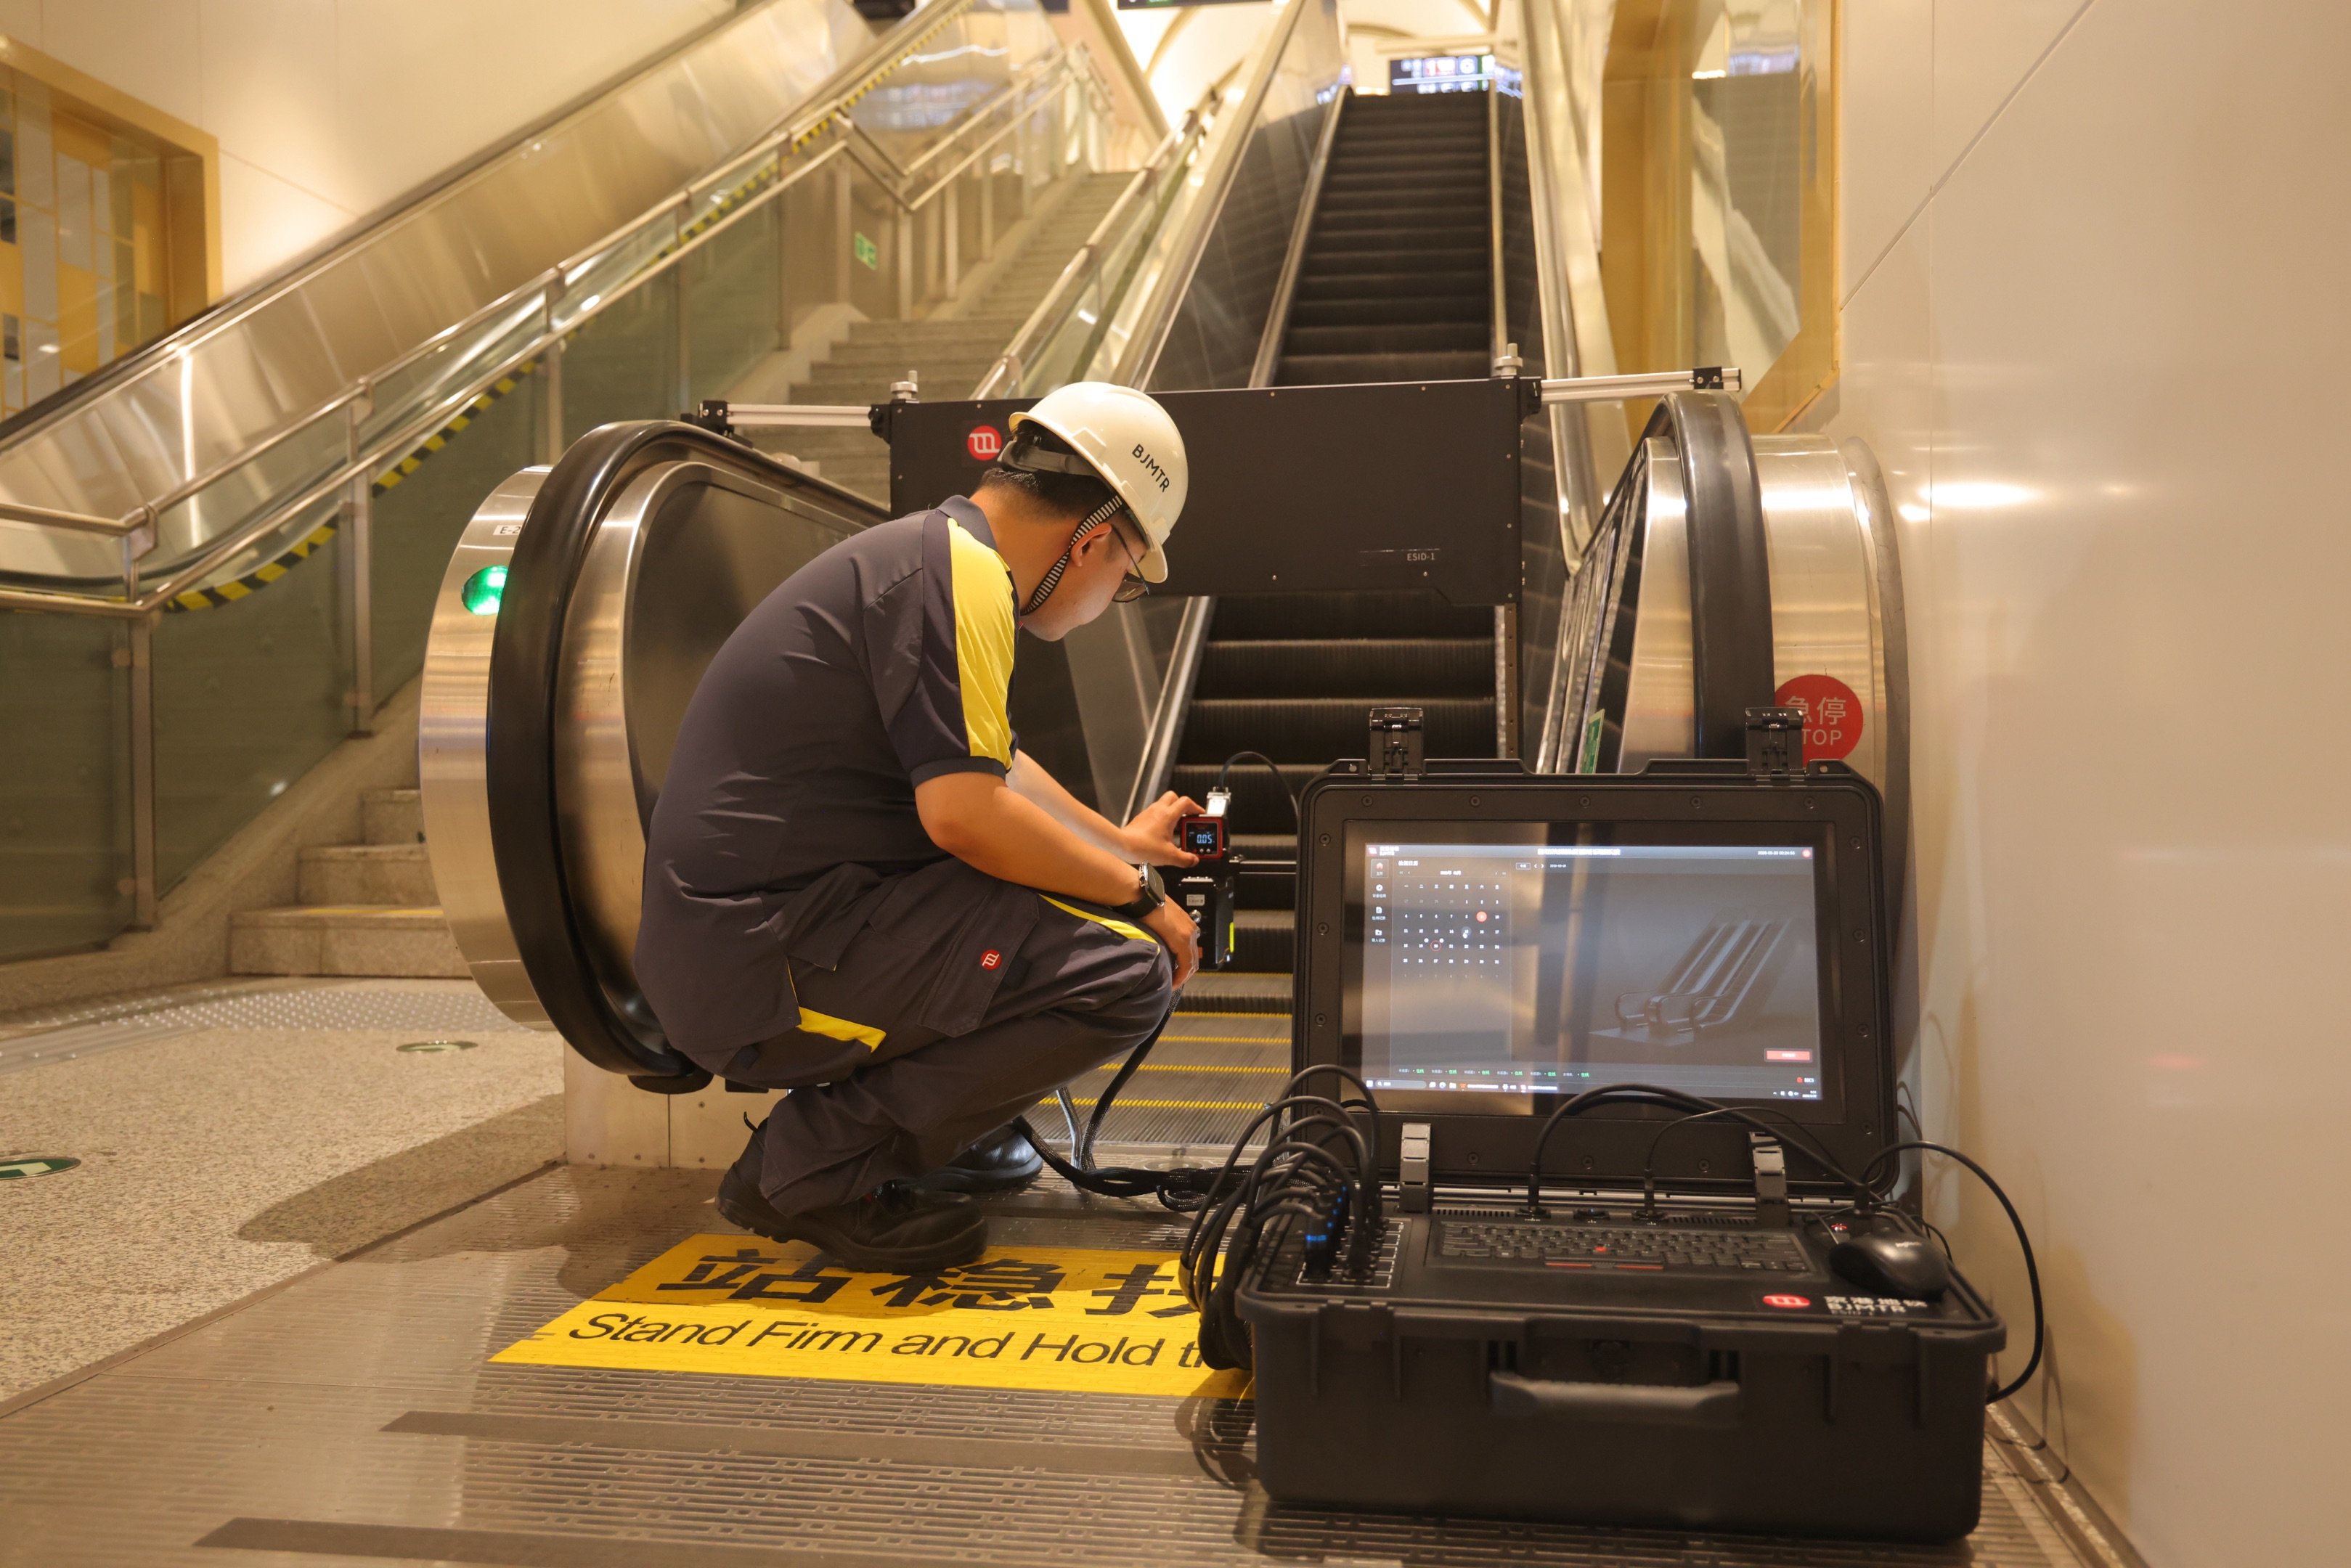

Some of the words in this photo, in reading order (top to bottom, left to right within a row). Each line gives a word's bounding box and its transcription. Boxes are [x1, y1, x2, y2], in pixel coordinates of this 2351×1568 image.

[1131, 444, 1170, 493] BJMTR
[1406, 552, 1435, 561] ESID-1
[1784, 695, 1847, 725] 急停
[1802, 728, 1843, 746] TOP
[1827, 1302, 1907, 1313] BJMTR
[569, 1312, 752, 1346] Stand
[748, 1321, 883, 1352] Firm
[890, 1331, 1014, 1359] and
[1020, 1333, 1166, 1366] Hold
